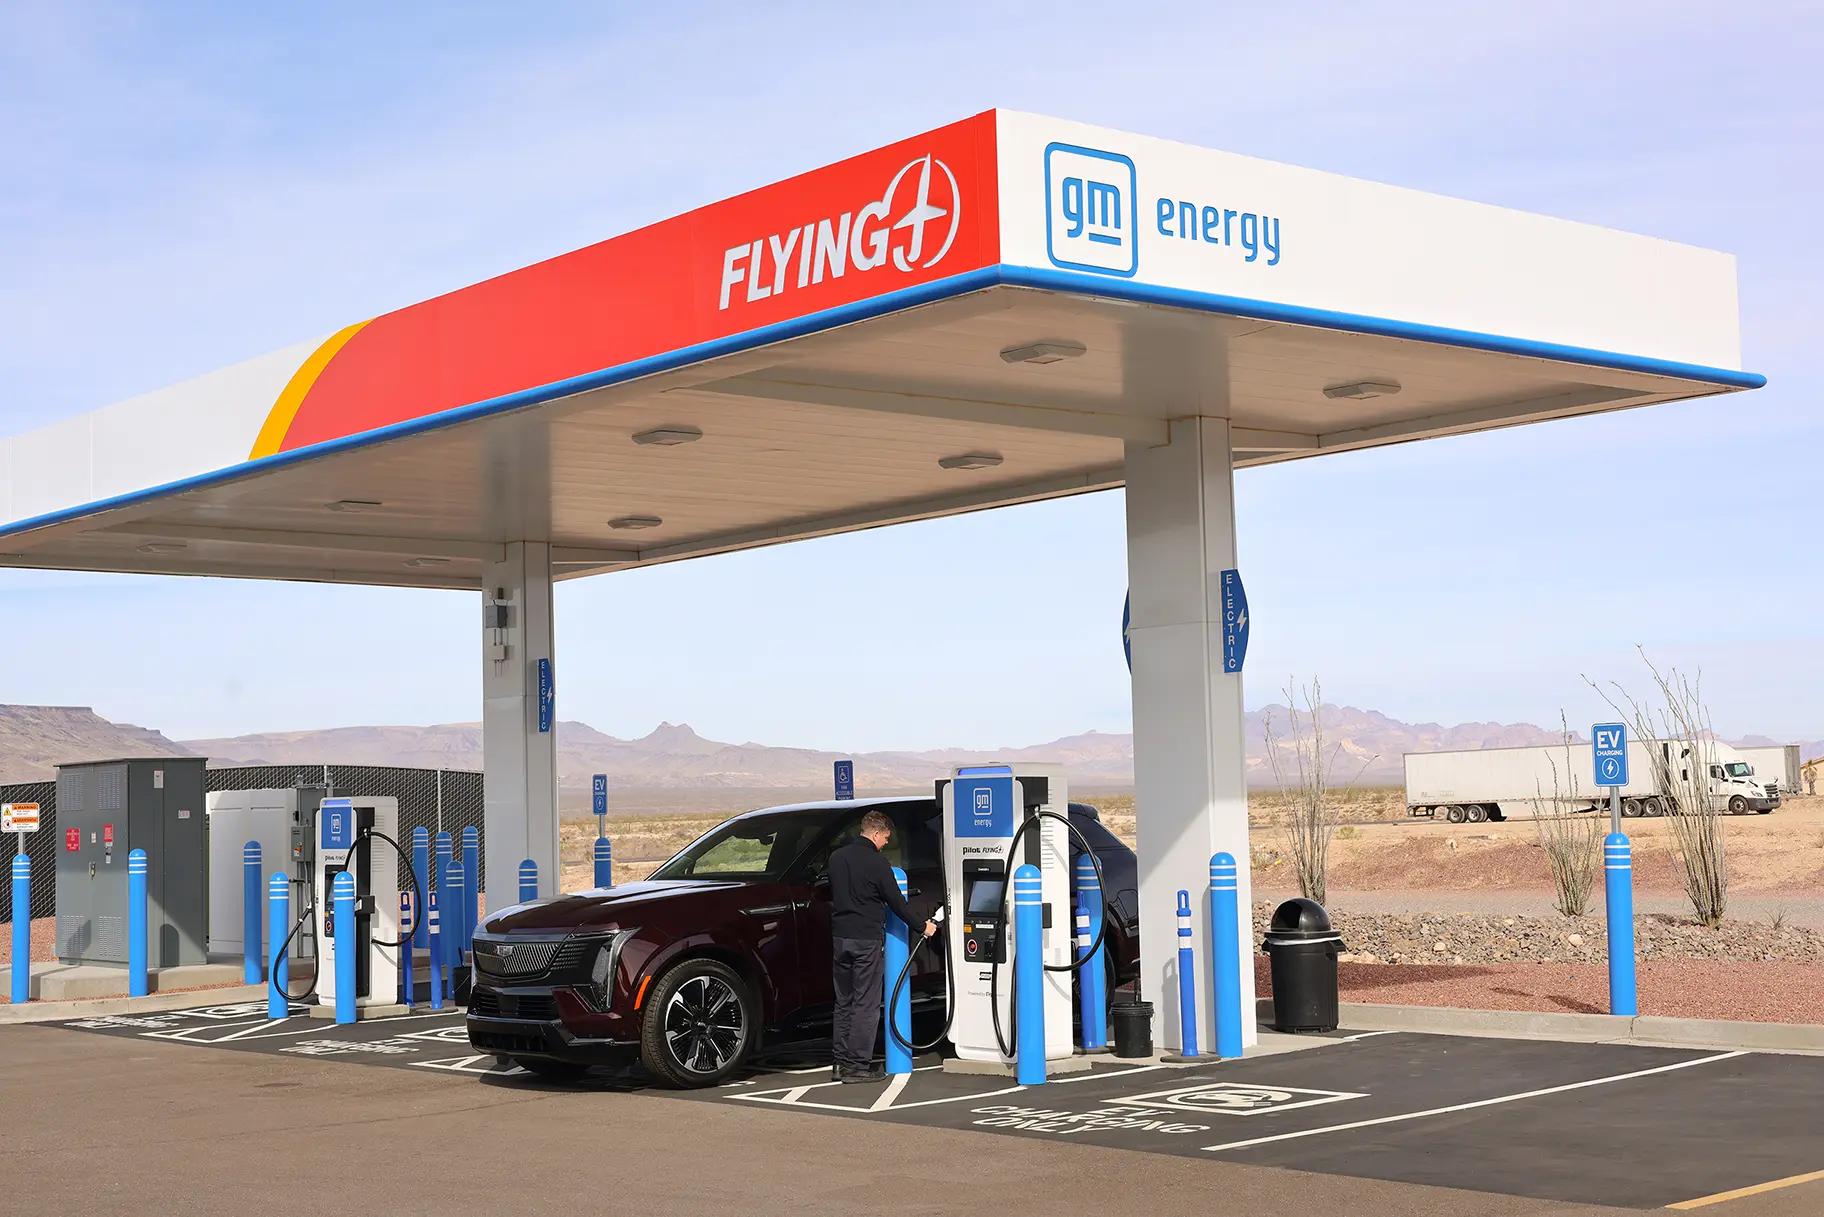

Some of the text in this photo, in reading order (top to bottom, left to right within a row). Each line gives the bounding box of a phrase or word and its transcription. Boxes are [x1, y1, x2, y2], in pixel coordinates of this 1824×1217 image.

[1062, 176, 1281, 266] gm energy
[718, 201, 890, 310] FLYING
[1226, 574, 1236, 669] ELECTRIC
[1597, 731, 1620, 749] EV
[595, 779, 605, 791] EV
[976, 794, 989, 809] gm
[974, 819, 992, 828] energy
[970, 1105, 1211, 1134] CHARGING
[972, 1117, 1113, 1134] ONLY
